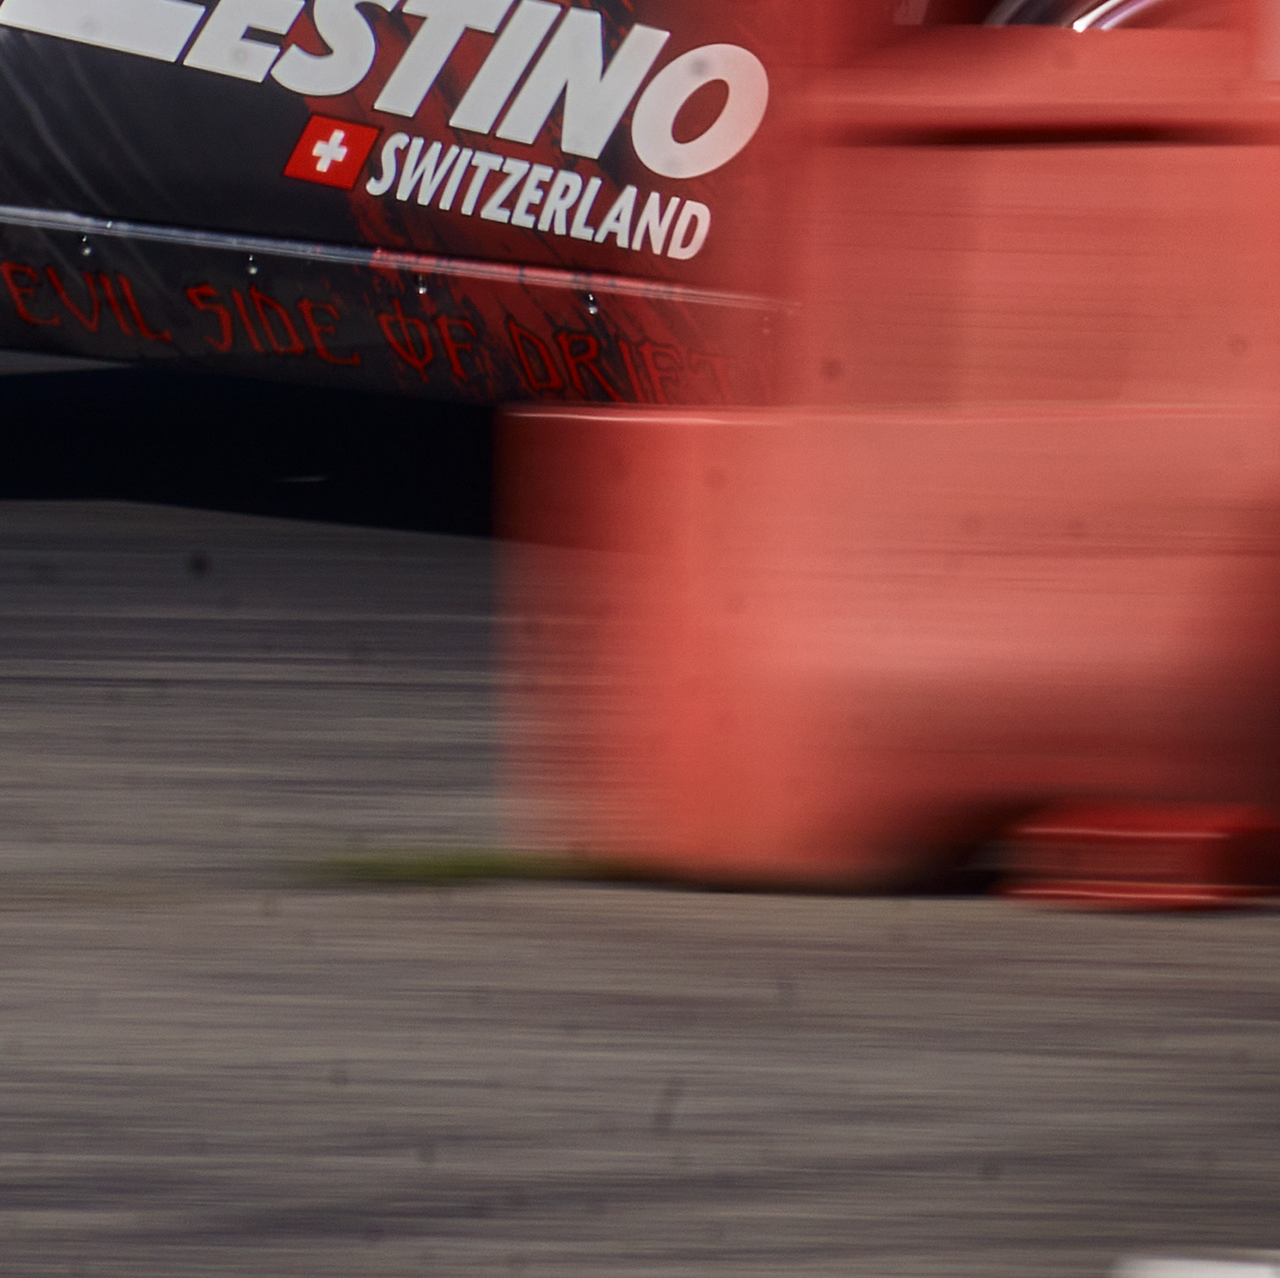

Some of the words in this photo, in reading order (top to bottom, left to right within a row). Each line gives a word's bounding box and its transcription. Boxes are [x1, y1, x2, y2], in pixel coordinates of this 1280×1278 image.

[366, 132, 711, 261] SWITZERLAND
[5, 261, 172, 342] EVIL
[187, 285, 362, 368] SIDE
